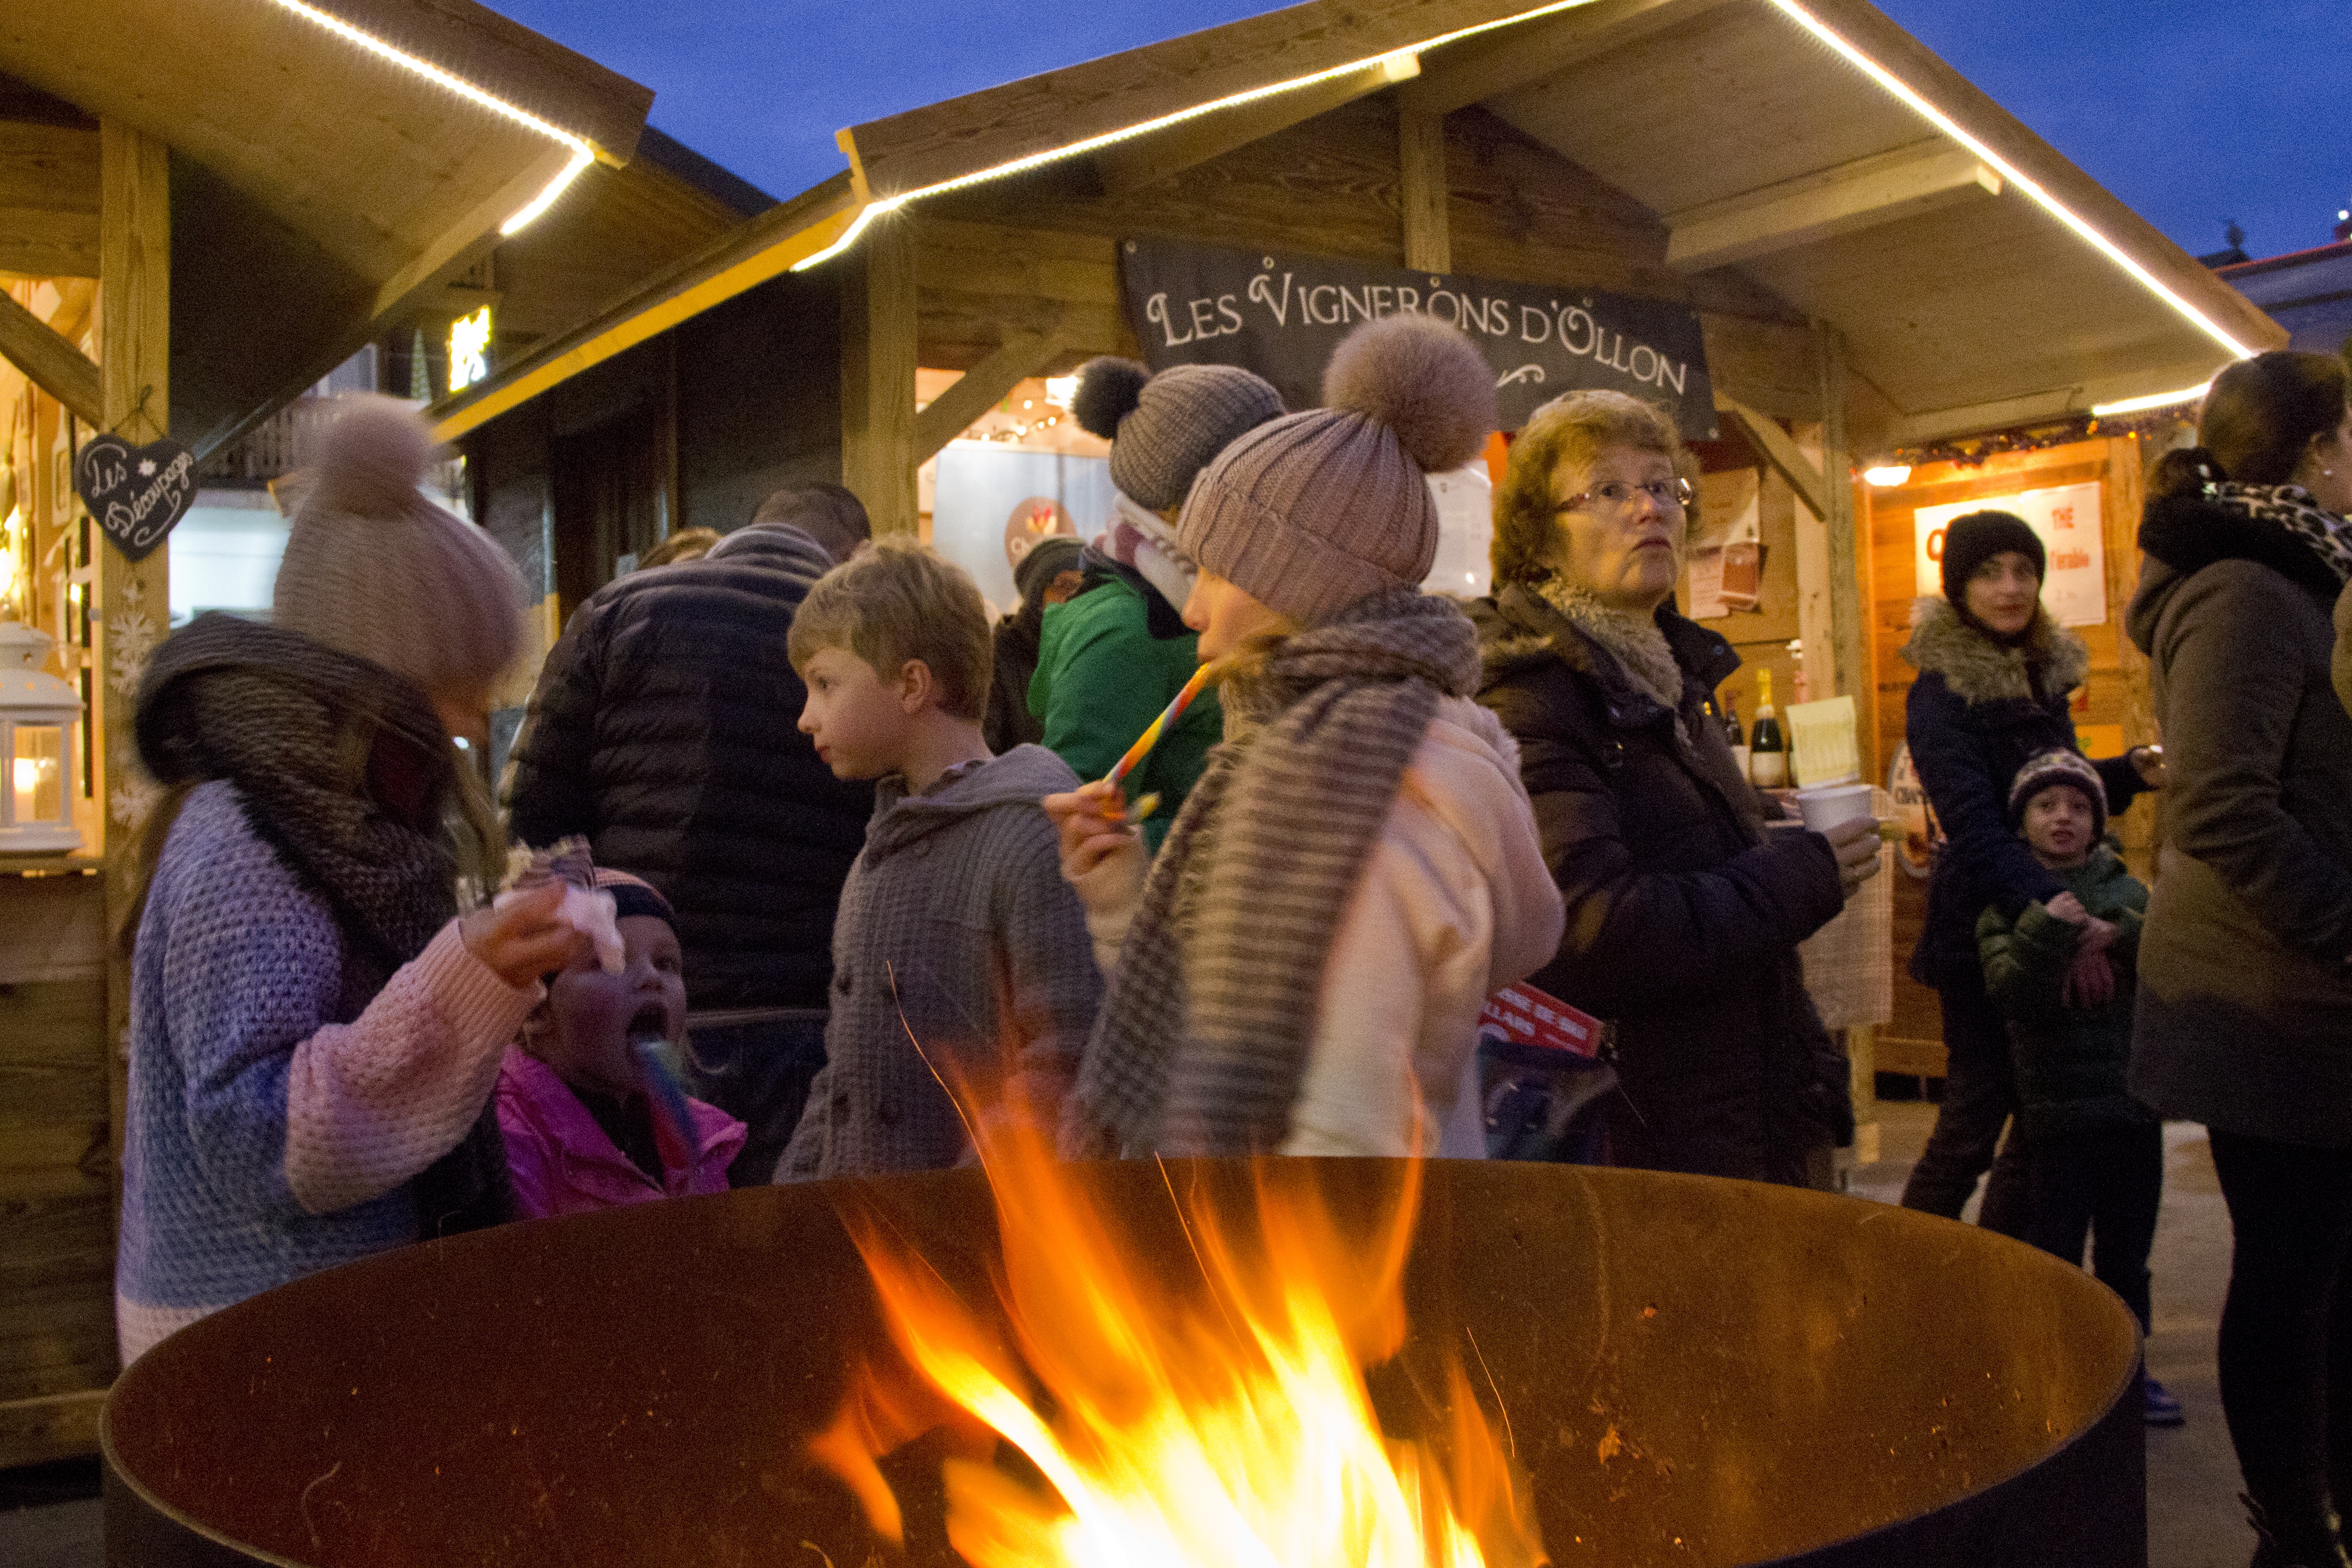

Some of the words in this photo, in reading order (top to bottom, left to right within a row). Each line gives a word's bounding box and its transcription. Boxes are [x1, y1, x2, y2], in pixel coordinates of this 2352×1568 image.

[1146, 292, 1243, 346] LES
[1248, 272, 1510, 336] VIGNERONS
[1520, 299, 1686, 395] D'OLLON
[85, 443, 128, 499] Les
